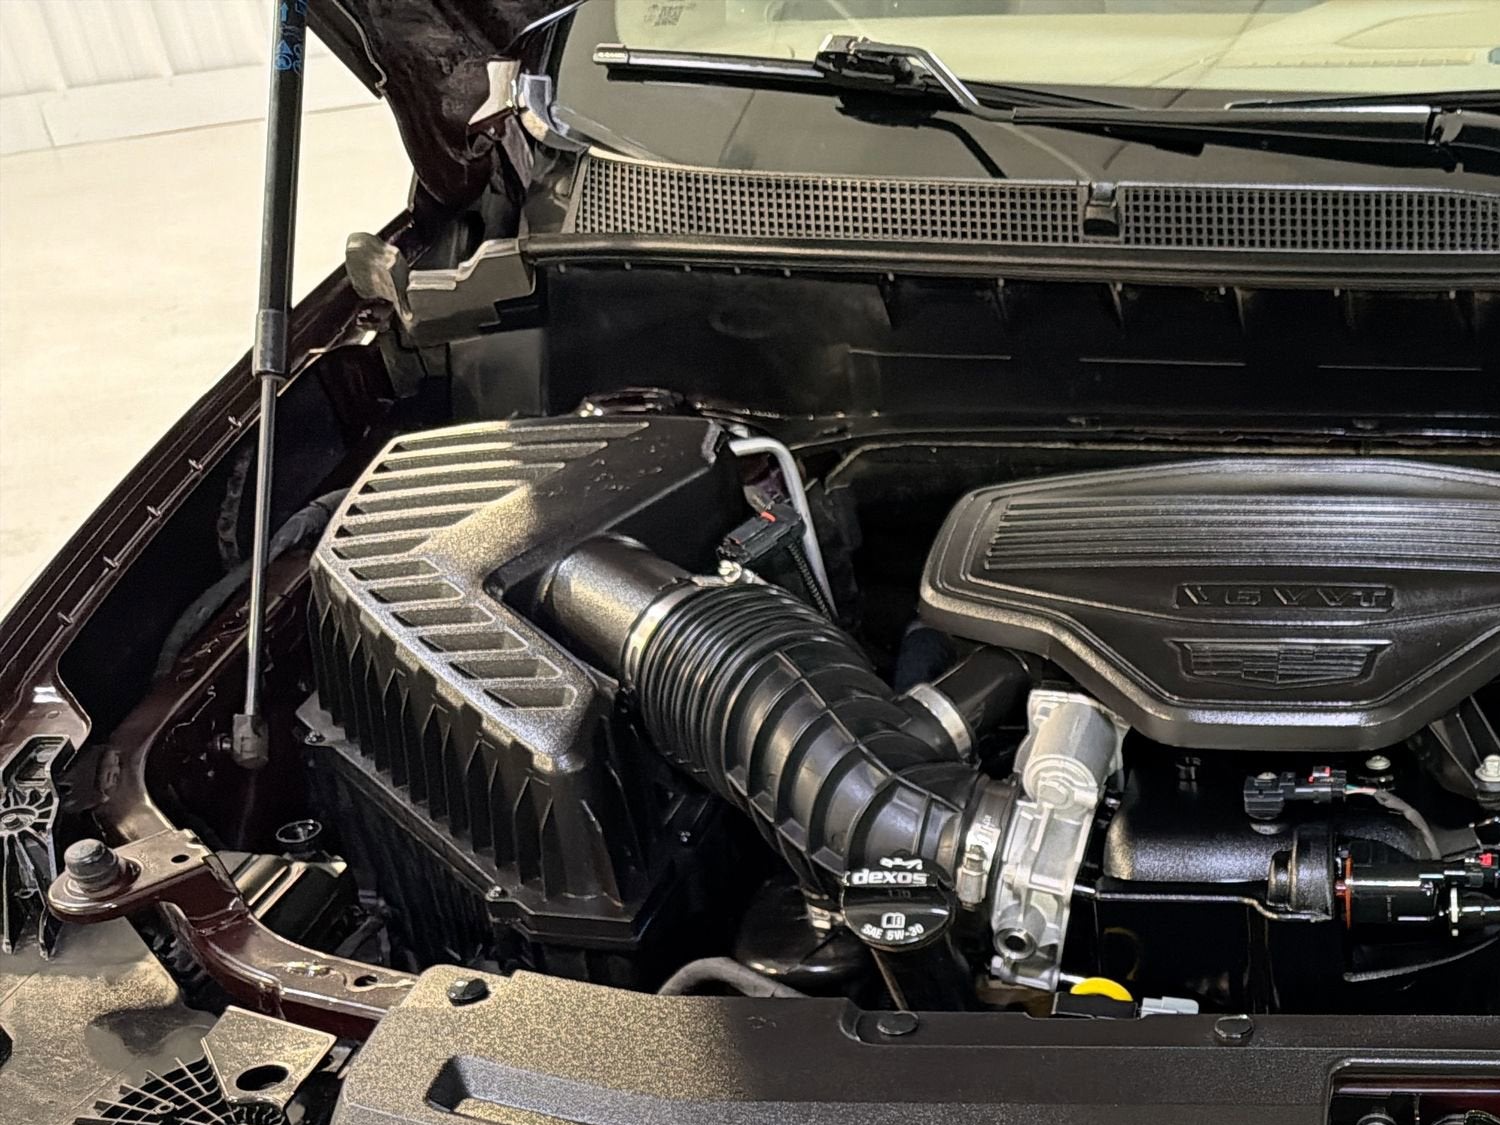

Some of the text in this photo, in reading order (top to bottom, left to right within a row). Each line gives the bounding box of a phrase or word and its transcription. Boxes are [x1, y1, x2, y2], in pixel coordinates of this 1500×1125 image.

[852, 868, 927, 885] dexos
[861, 922, 924, 941] SAE 5W-30
